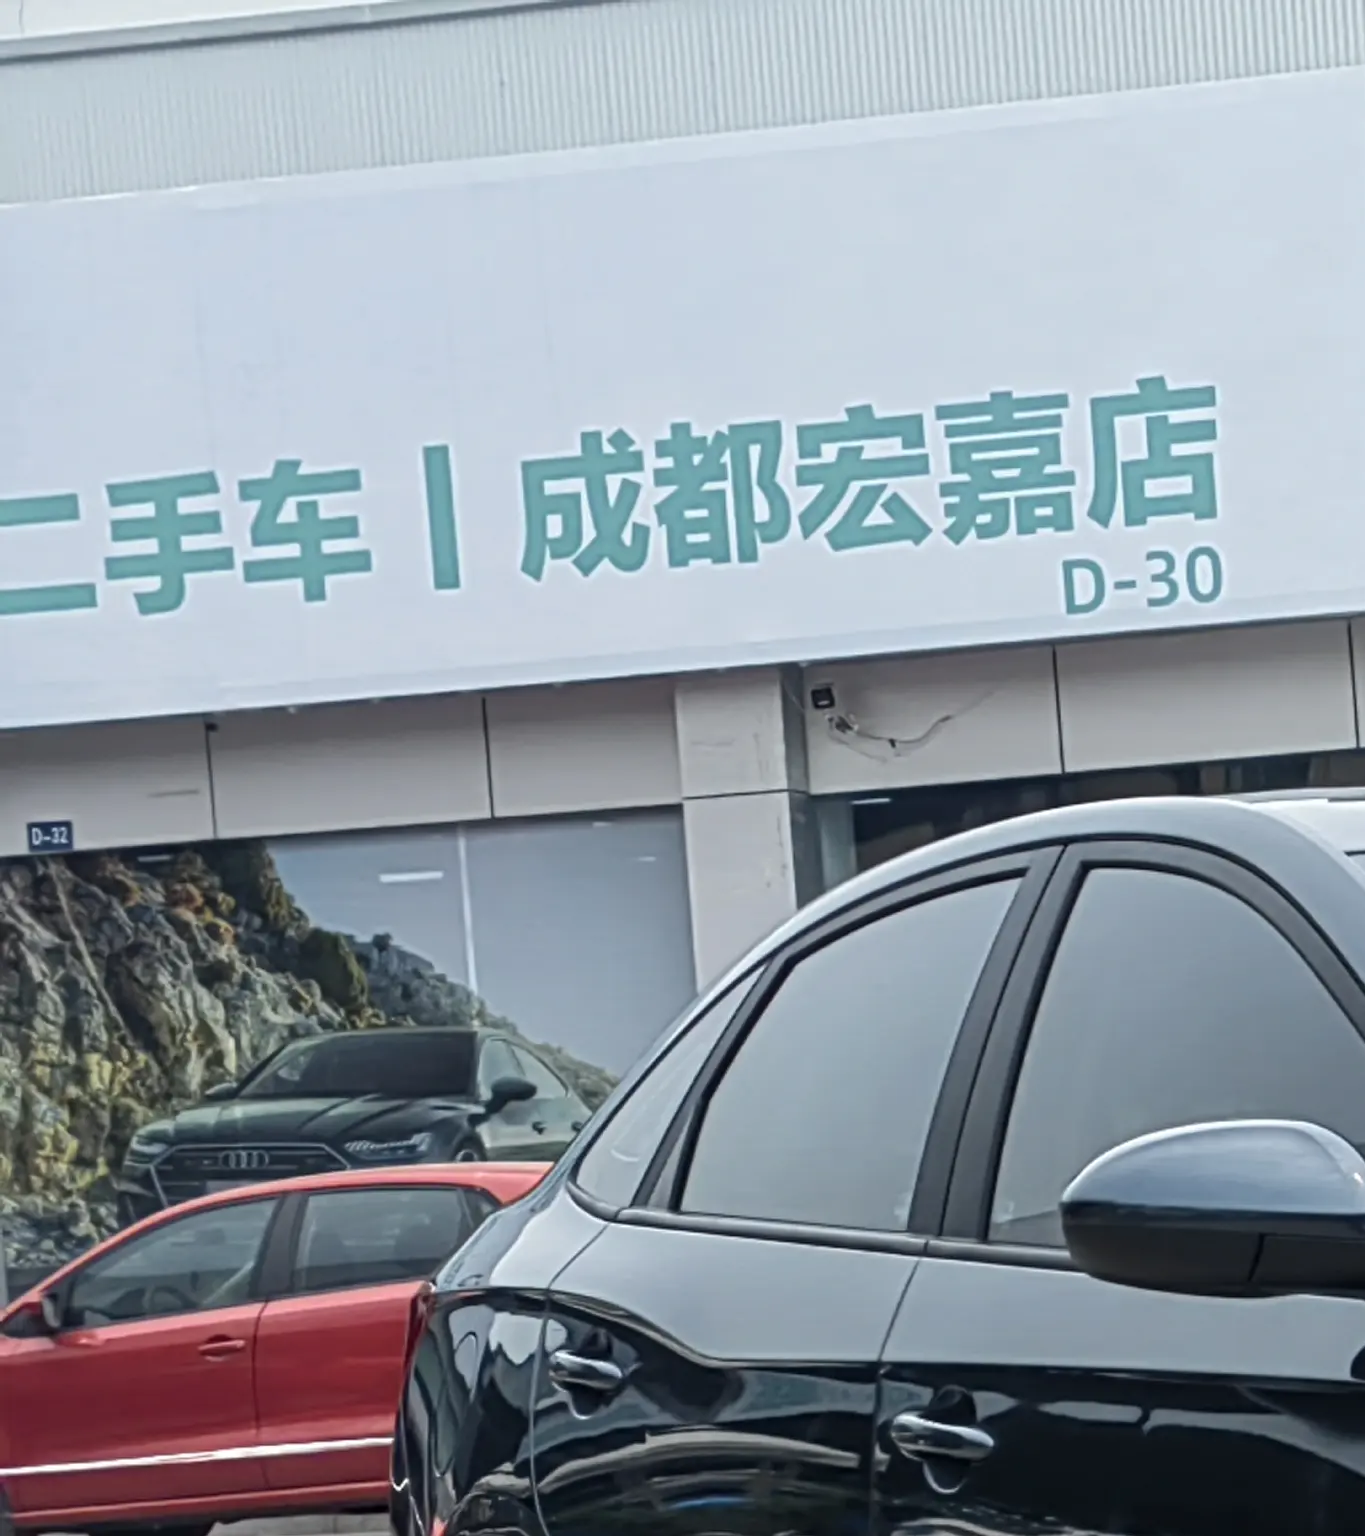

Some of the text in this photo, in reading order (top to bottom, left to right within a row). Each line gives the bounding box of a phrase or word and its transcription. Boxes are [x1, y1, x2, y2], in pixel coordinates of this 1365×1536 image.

[520, 376, 1220, 584] 成都宏嘉店
[1062, 546, 1222, 615] D-30
[31, 826, 70, 846] D-32
